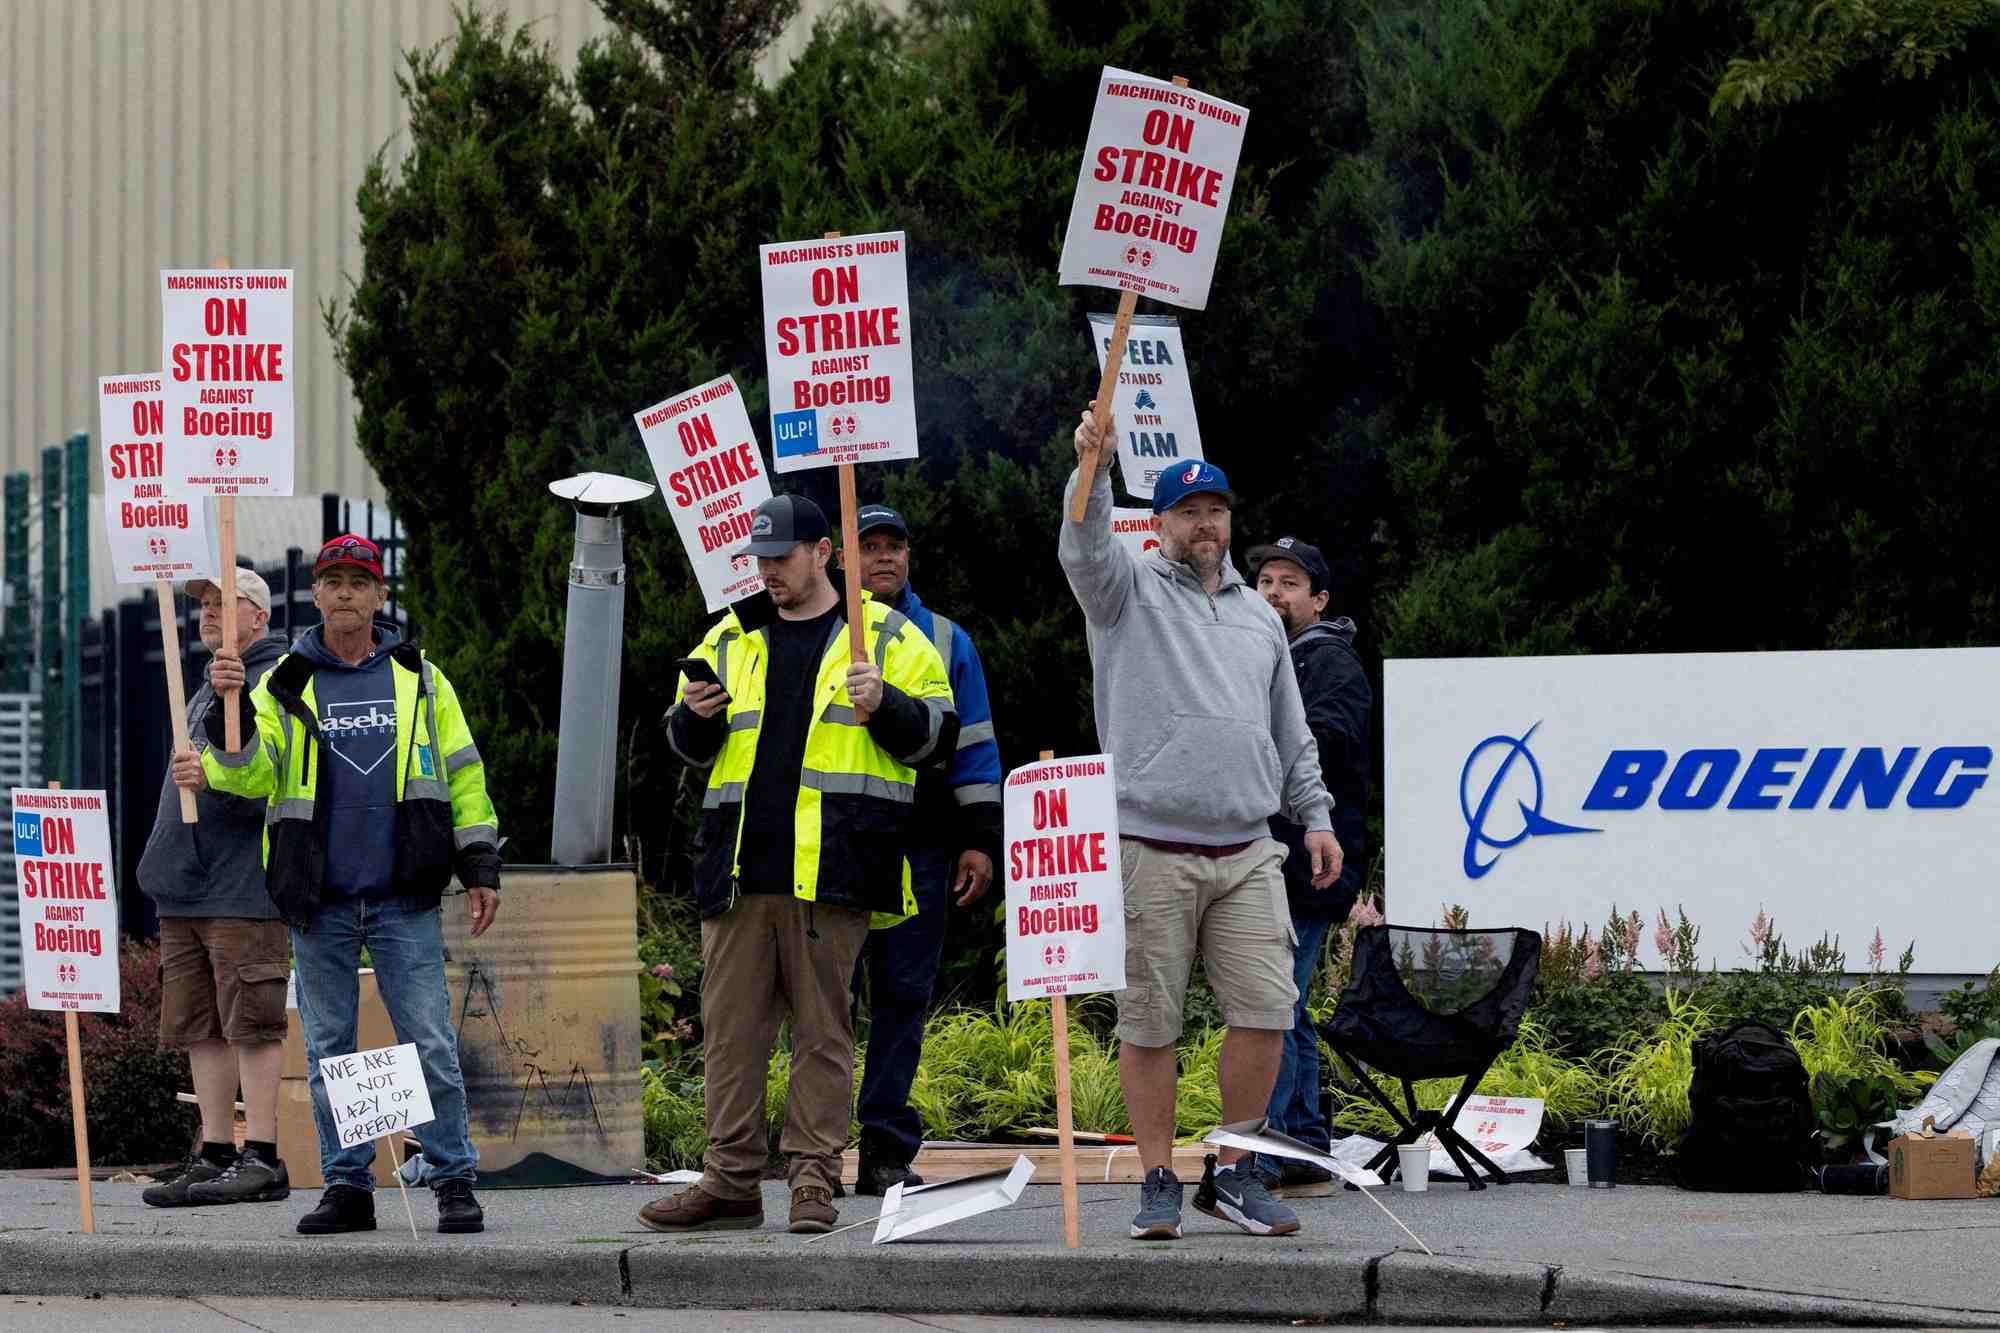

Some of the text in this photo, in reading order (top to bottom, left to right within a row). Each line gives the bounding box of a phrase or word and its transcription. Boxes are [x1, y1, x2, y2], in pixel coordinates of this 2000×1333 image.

[1107, 82, 1241, 127] MACHINISTS UNION
[1142, 109, 1195, 154] ON
[1094, 146, 1223, 208] STRIKE
[1120, 190, 1183, 217] AGAINST
[1094, 203, 1198, 253] Boeing
[768, 240, 899, 265] MACHINISTS UNION
[167, 276, 287, 290] MACHINISTS UNION
[812, 265, 859, 307] ON
[204, 298, 247, 336] ON
[776, 307, 900, 356] STRIKE
[172, 344, 283, 381] STRIKE
[811, 355, 870, 376] AGAINST
[1104, 337, 1173, 365] EEA
[104, 380, 161, 395] MACHINISTS
[794, 375, 891, 409] Boeing
[1120, 372, 1162, 384] STANDS
[200, 389, 254, 404] AGAINST
[642, 381, 734, 429] MACHINISTS UNION
[132, 400, 163, 437] ON
[183, 407, 273, 439] Boeing
[678, 412, 717, 457] ON
[778, 420, 813, 440] ULP!
[1134, 414, 1162, 425] WITH
[110, 442, 162, 479] STRI
[1129, 431, 1178, 457] IAM
[134, 484, 162, 498] AGAIN
[669, 441, 759, 508] STRIKE
[121, 501, 189, 529] Boeing
[703, 491, 743, 520] AGAINST
[319, 707, 397, 731] aseba
[1008, 762, 1105, 786] MACHINISTS UNION
[1582, 746, 1993, 810] BOEING
[16, 794, 101, 810] MACHINISTS UNION
[1033, 788, 1068, 830] ON
[17, 823, 39, 840] ULP!
[42, 816, 75, 855] ON
[1010, 832, 1107, 881] STRIKE
[23, 860, 106, 900] STRIKE
[1030, 882, 1078, 901] AGAINST
[45, 905, 84, 922] AGAINST
[1018, 901, 1098, 937] Boeing
[35, 922, 101, 956] Boeing
[323, 1048, 397, 1080] WE ARE
[356, 1072, 397, 1093] NOT
[334, 1088, 416, 1124] LAZY OR
[343, 1108, 409, 1143] GREEDY
